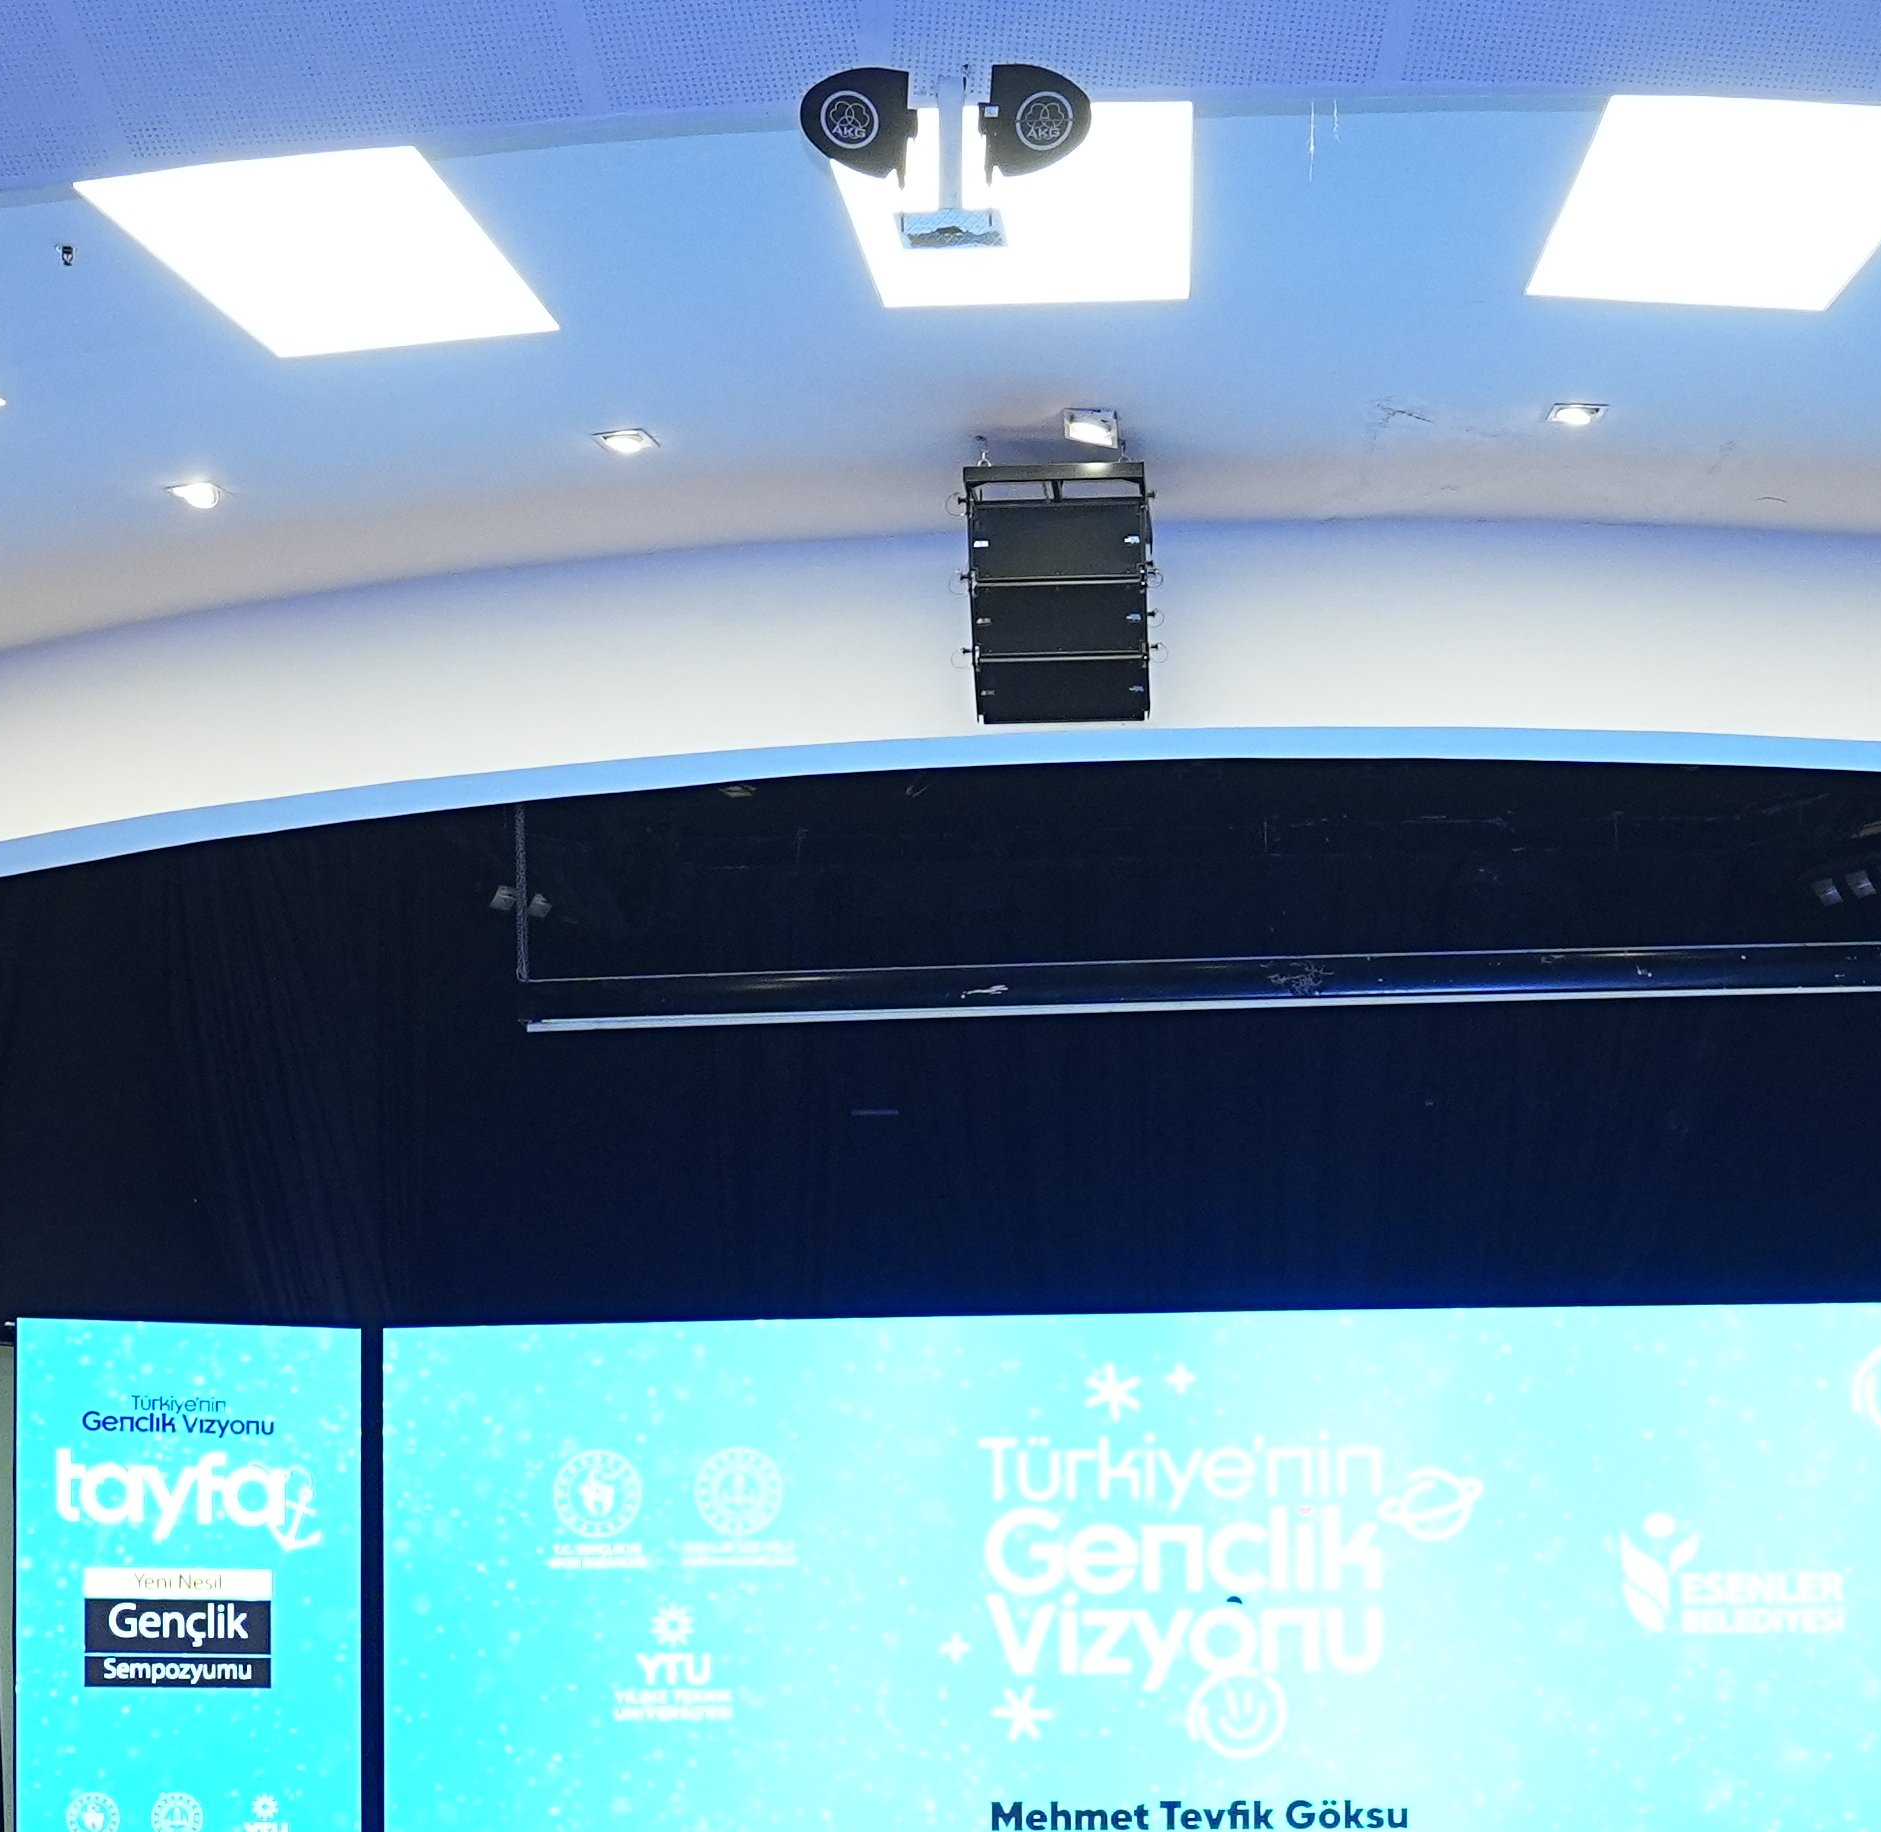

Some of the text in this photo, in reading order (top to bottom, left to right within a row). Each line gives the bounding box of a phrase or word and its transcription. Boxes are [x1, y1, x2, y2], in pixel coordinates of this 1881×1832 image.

[831, 125, 866, 140] AKG
[1026, 125, 1061, 140] AKG
[56, 1448, 287, 1543] tayfa
[135, 1574, 221, 1589] Yeni Nesil
[1682, 1571, 1843, 1604] ESENLER
[109, 1603, 248, 1647] Gençlik
[986, 1593, 1384, 1692] Vizyonu
[103, 1657, 252, 1685] Sempozyumu
[637, 1653, 711, 1685] YTU
[992, 1800, 1407, 1831] Mehmet Tevfik Göksu
